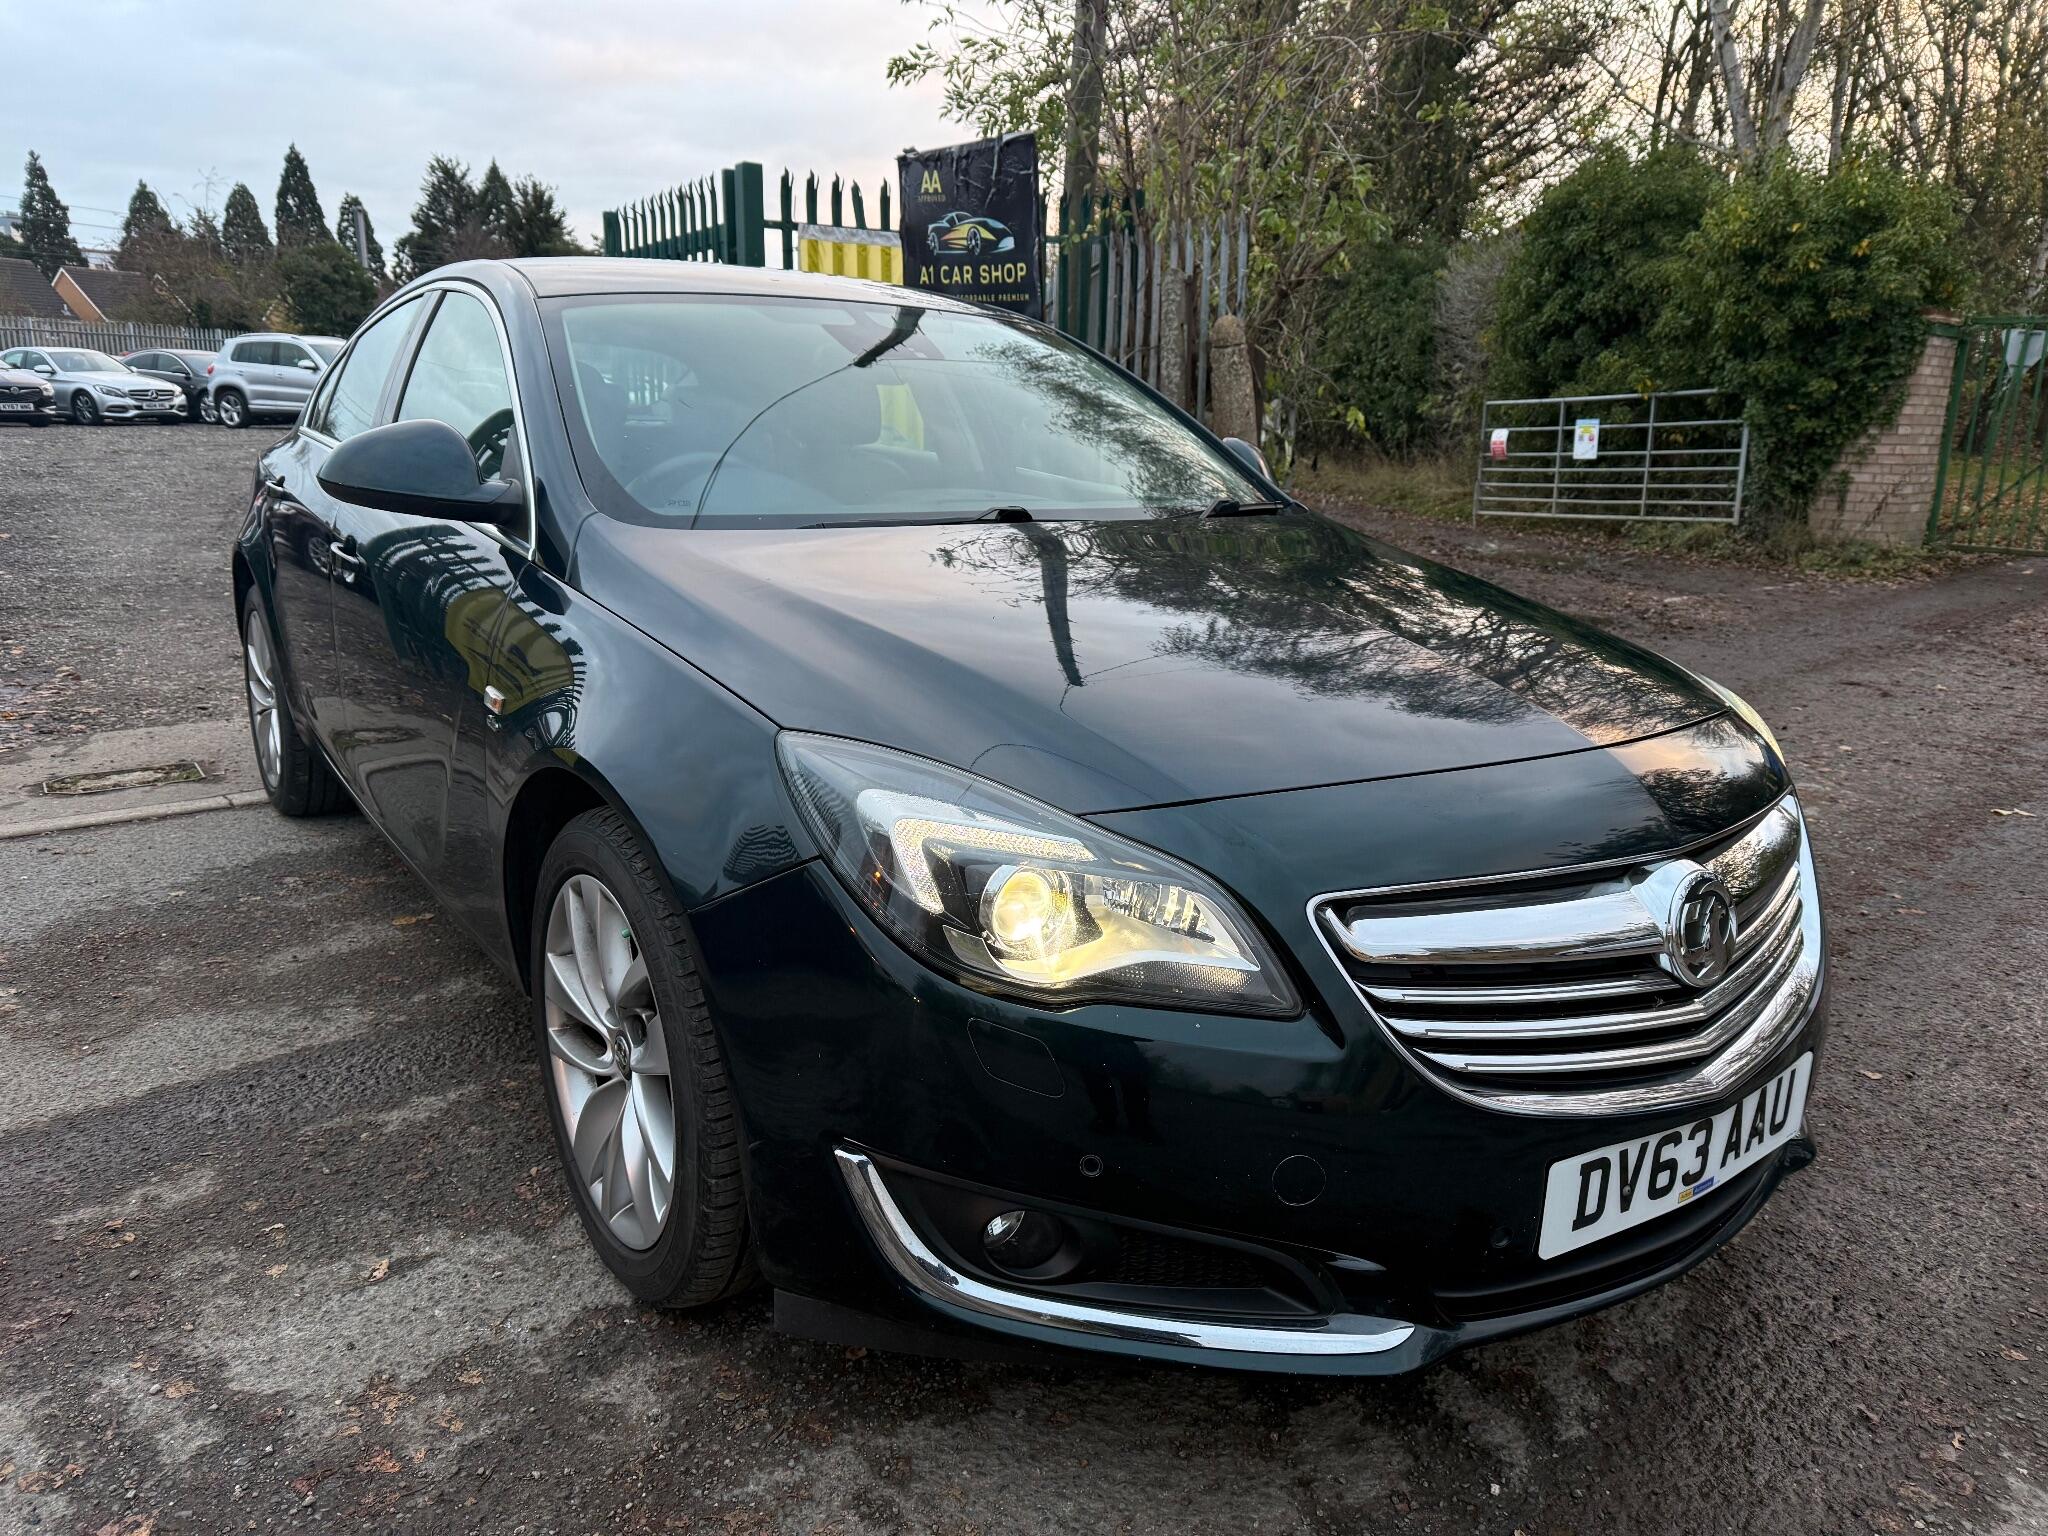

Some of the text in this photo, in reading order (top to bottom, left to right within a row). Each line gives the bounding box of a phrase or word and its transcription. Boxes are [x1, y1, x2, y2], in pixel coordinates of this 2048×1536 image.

[920, 169, 942, 193] AA
[920, 262, 1027, 284] A1 CAR SHOP
[998, 293, 1030, 302] PREMIUM
[1572, 1068, 1797, 1232] DV63 AAU
